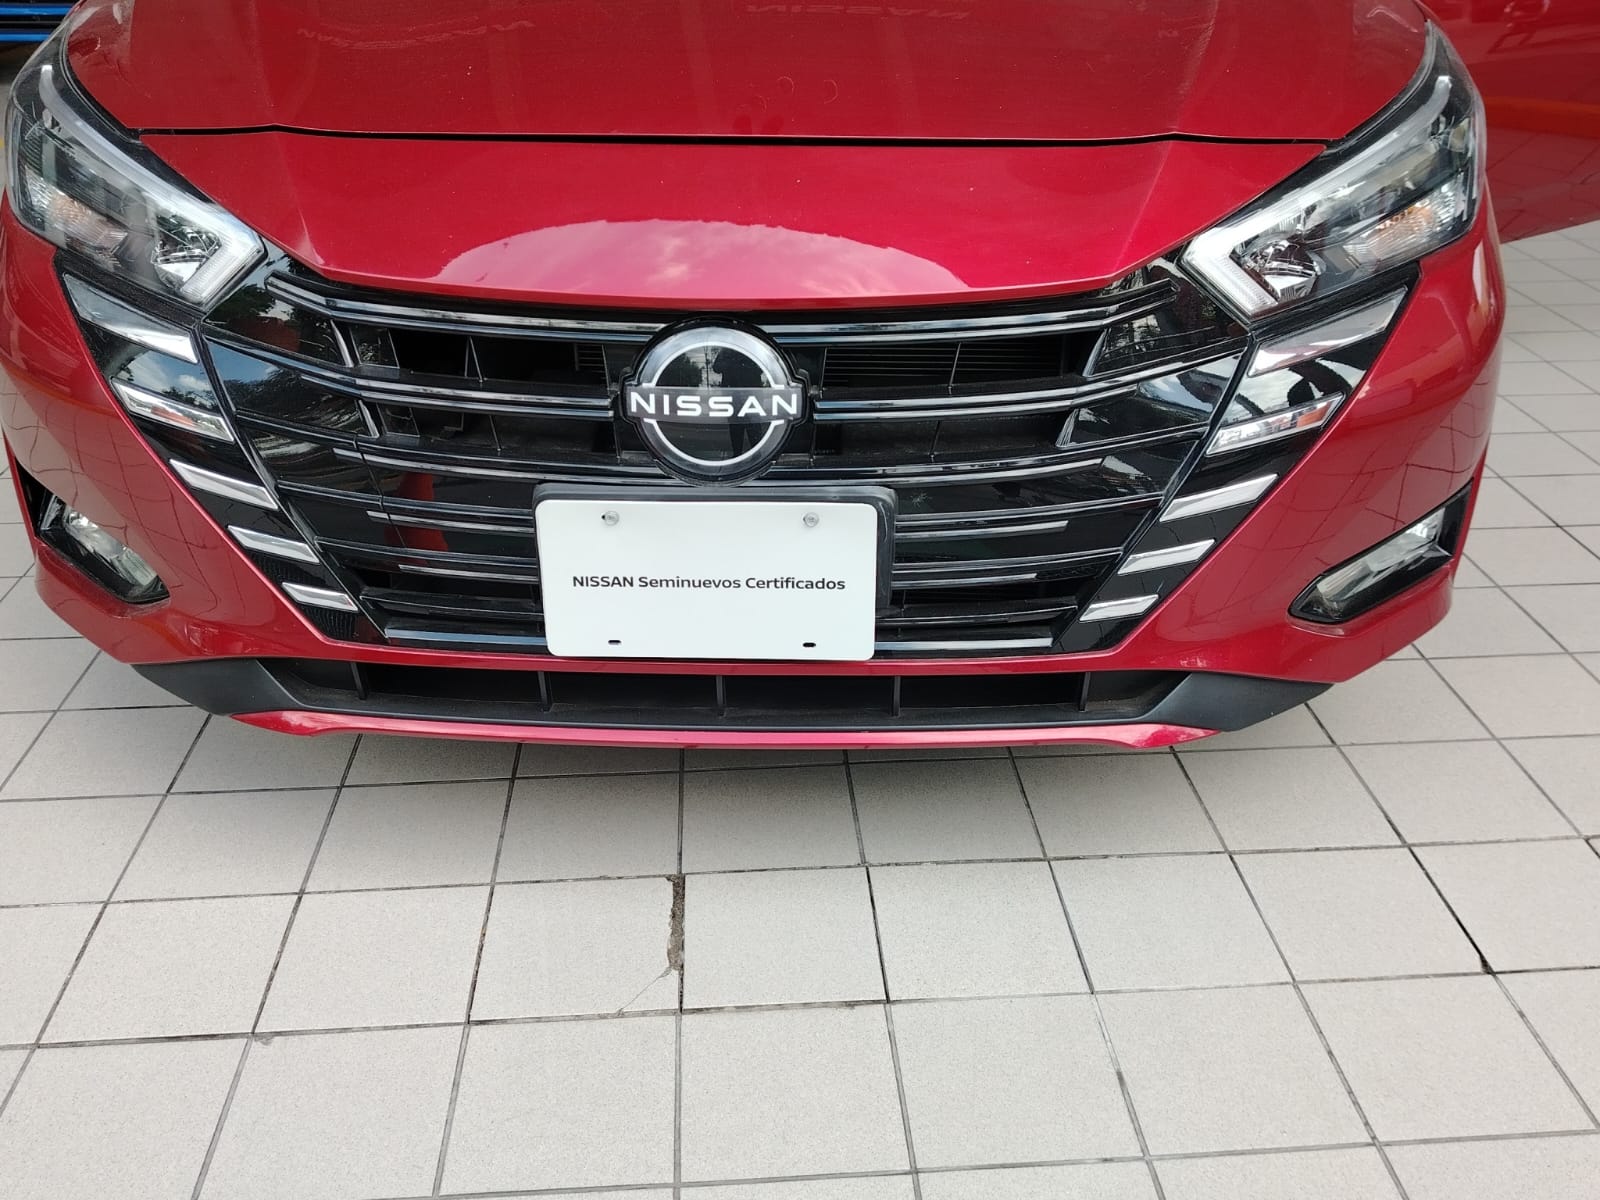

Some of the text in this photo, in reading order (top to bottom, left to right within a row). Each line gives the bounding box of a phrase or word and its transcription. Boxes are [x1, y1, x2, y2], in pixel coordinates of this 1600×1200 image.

[630, 391, 798, 417] NISSAN
[572, 576, 846, 590] NISSAN Seminuevos Certificados
